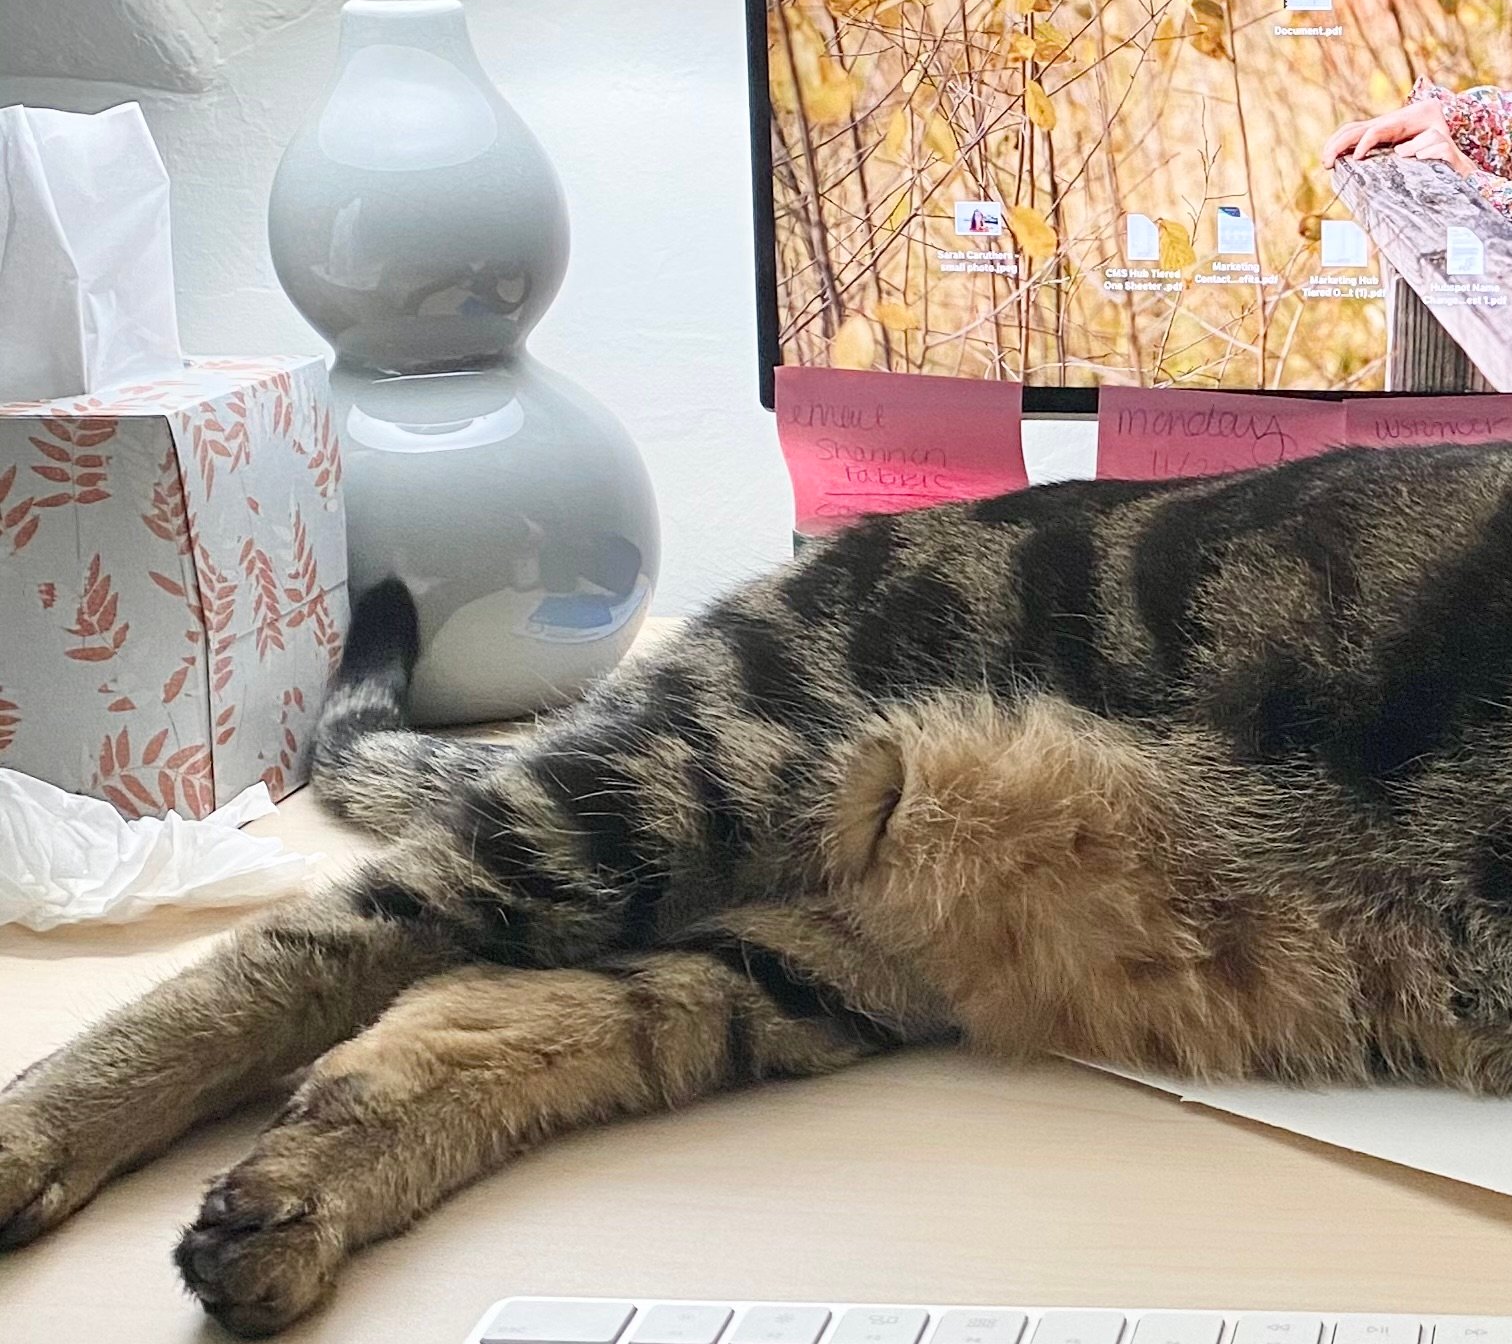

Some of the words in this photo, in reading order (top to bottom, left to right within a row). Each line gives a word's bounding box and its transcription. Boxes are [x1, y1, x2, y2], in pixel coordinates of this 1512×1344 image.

[1274, 26, 1343, 36] Document.pdf
[937, 251, 965, 259] Sarah
[941, 264, 966, 272] small
[1212, 262, 1260, 272] Marketing
[1105, 269, 1128, 278] CMS
[1129, 269, 1149, 278] Hub
[1310, 276, 1357, 286] Marketing
[1358, 276, 1379, 285] Hub
[1430, 283, 1471, 293] Hubspot
[1472, 284, 1500, 293] Name
